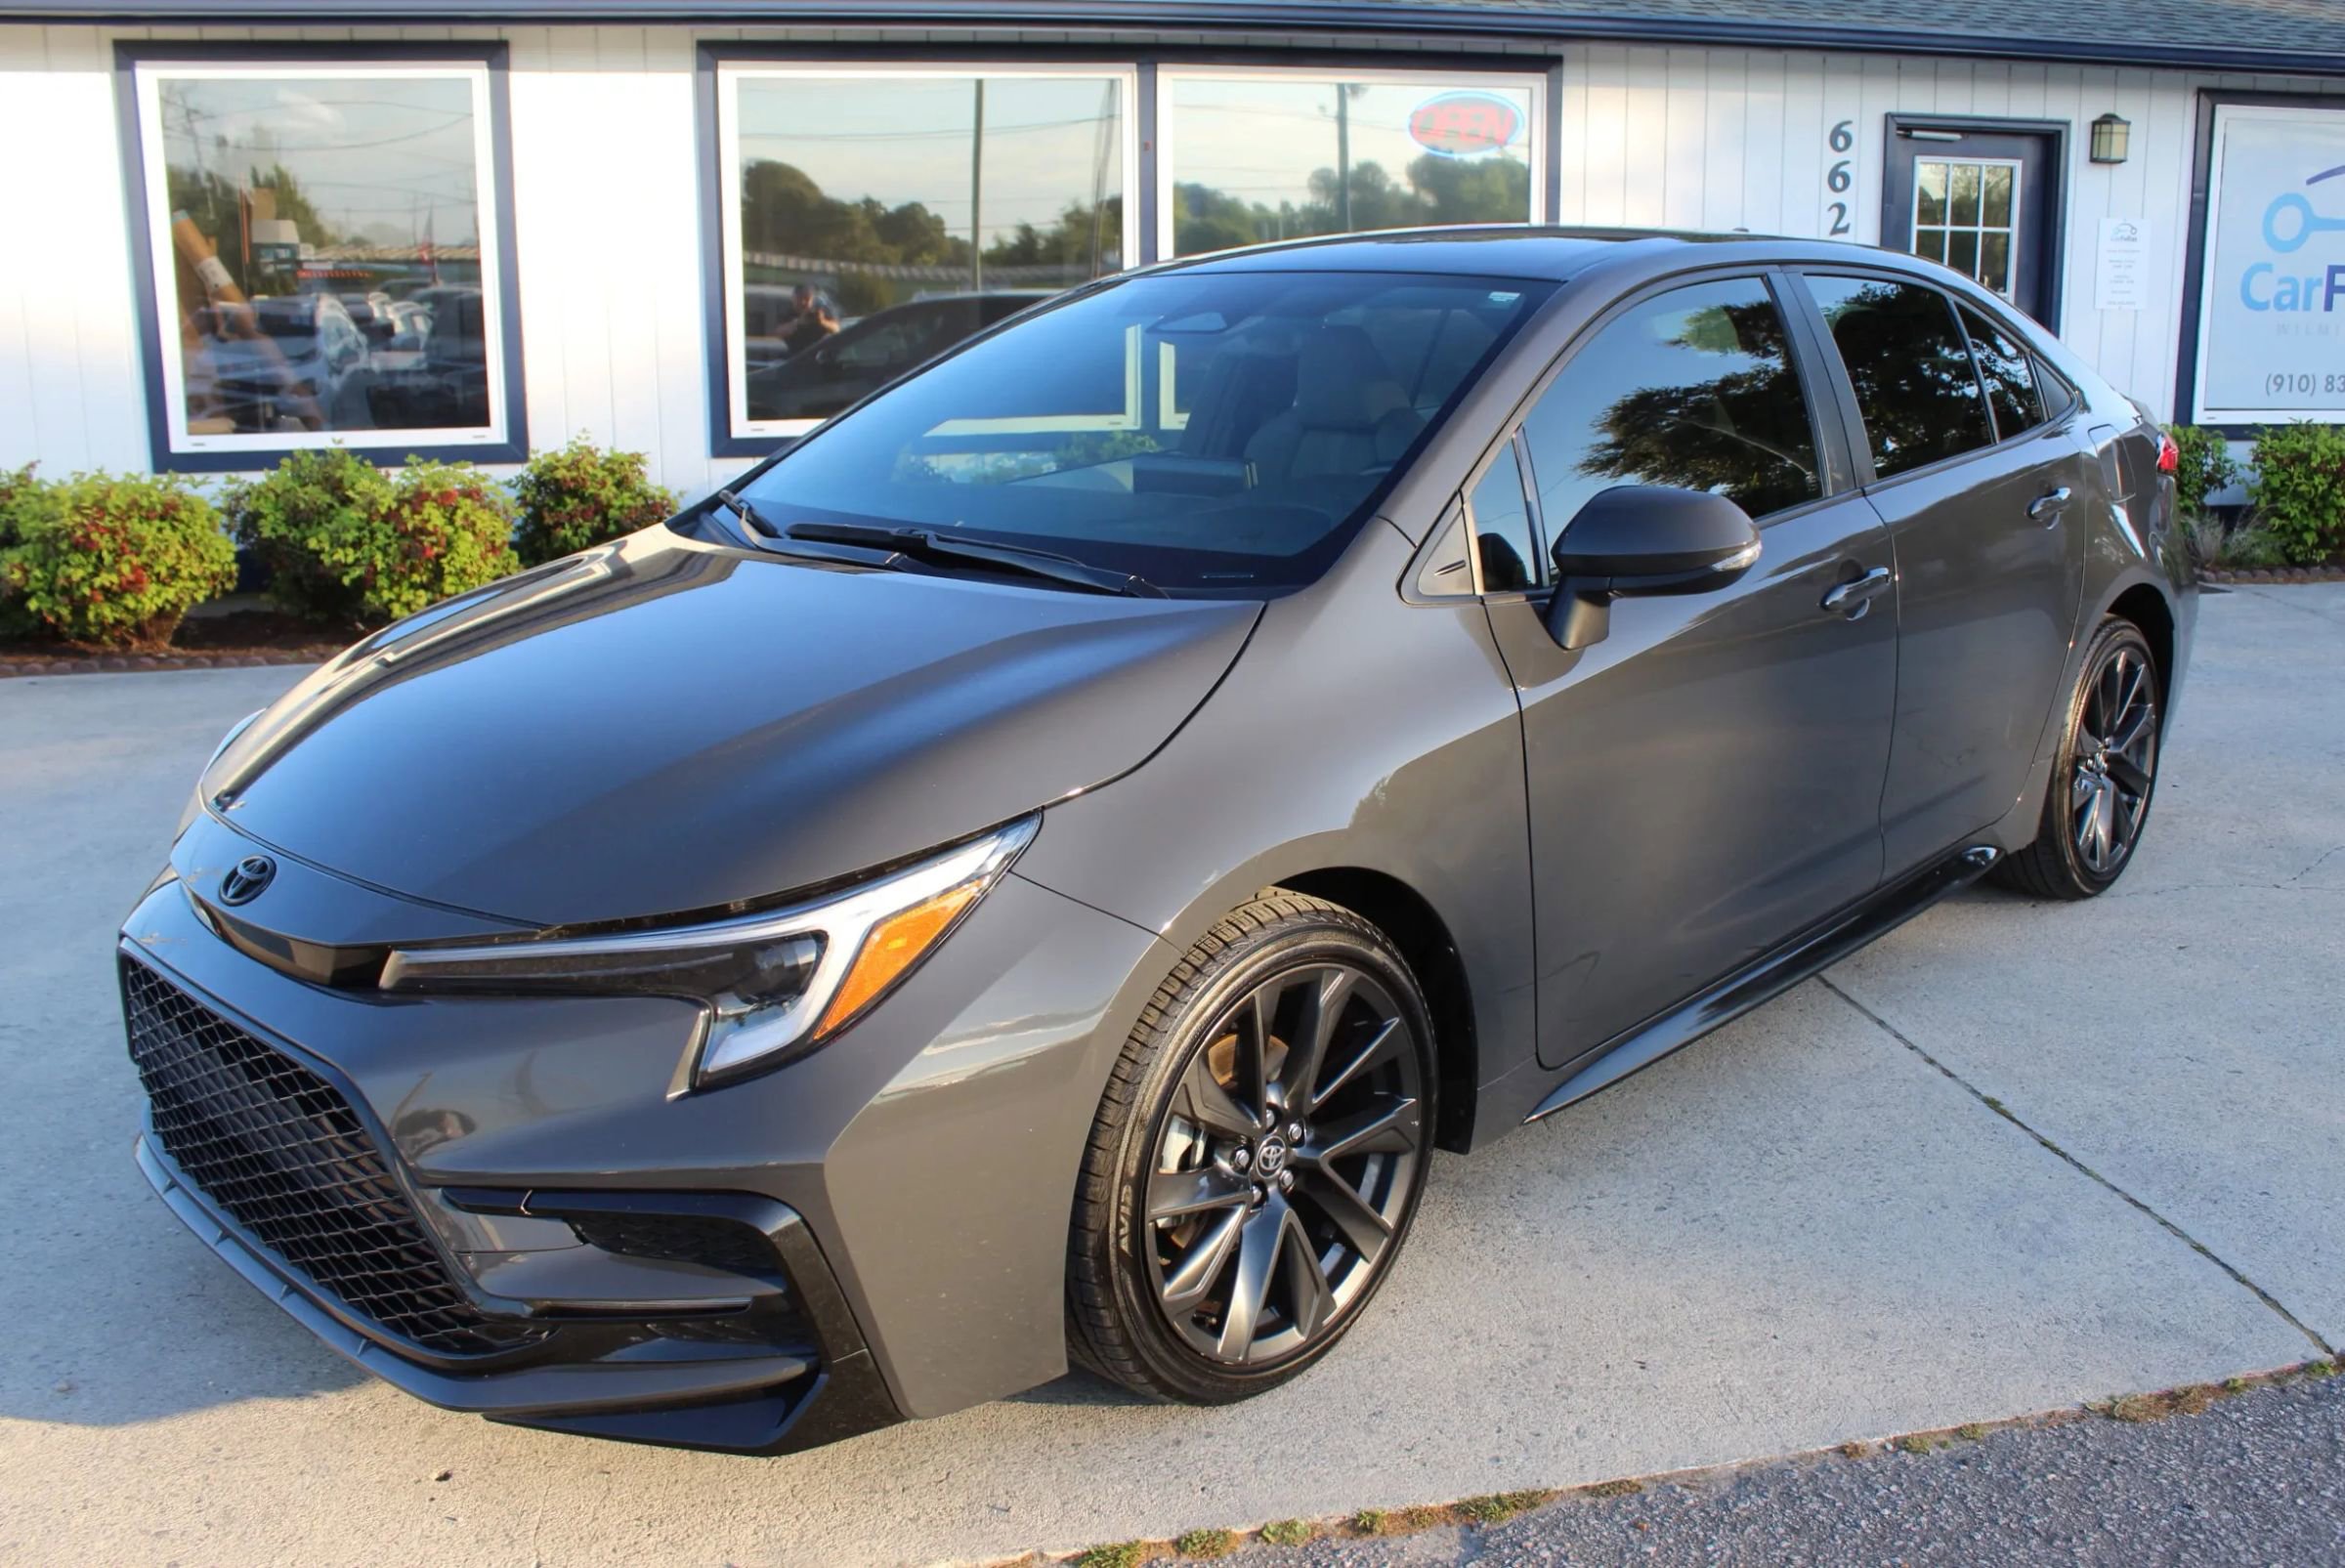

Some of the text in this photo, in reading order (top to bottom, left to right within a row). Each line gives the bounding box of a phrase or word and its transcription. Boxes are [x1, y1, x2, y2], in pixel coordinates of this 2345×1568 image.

[1410, 105, 1514, 146] OPEN
[1827, 120, 1853, 236] 662
[2240, 261, 2345, 312] CarF
[2265, 373, 2317, 397] (910)
